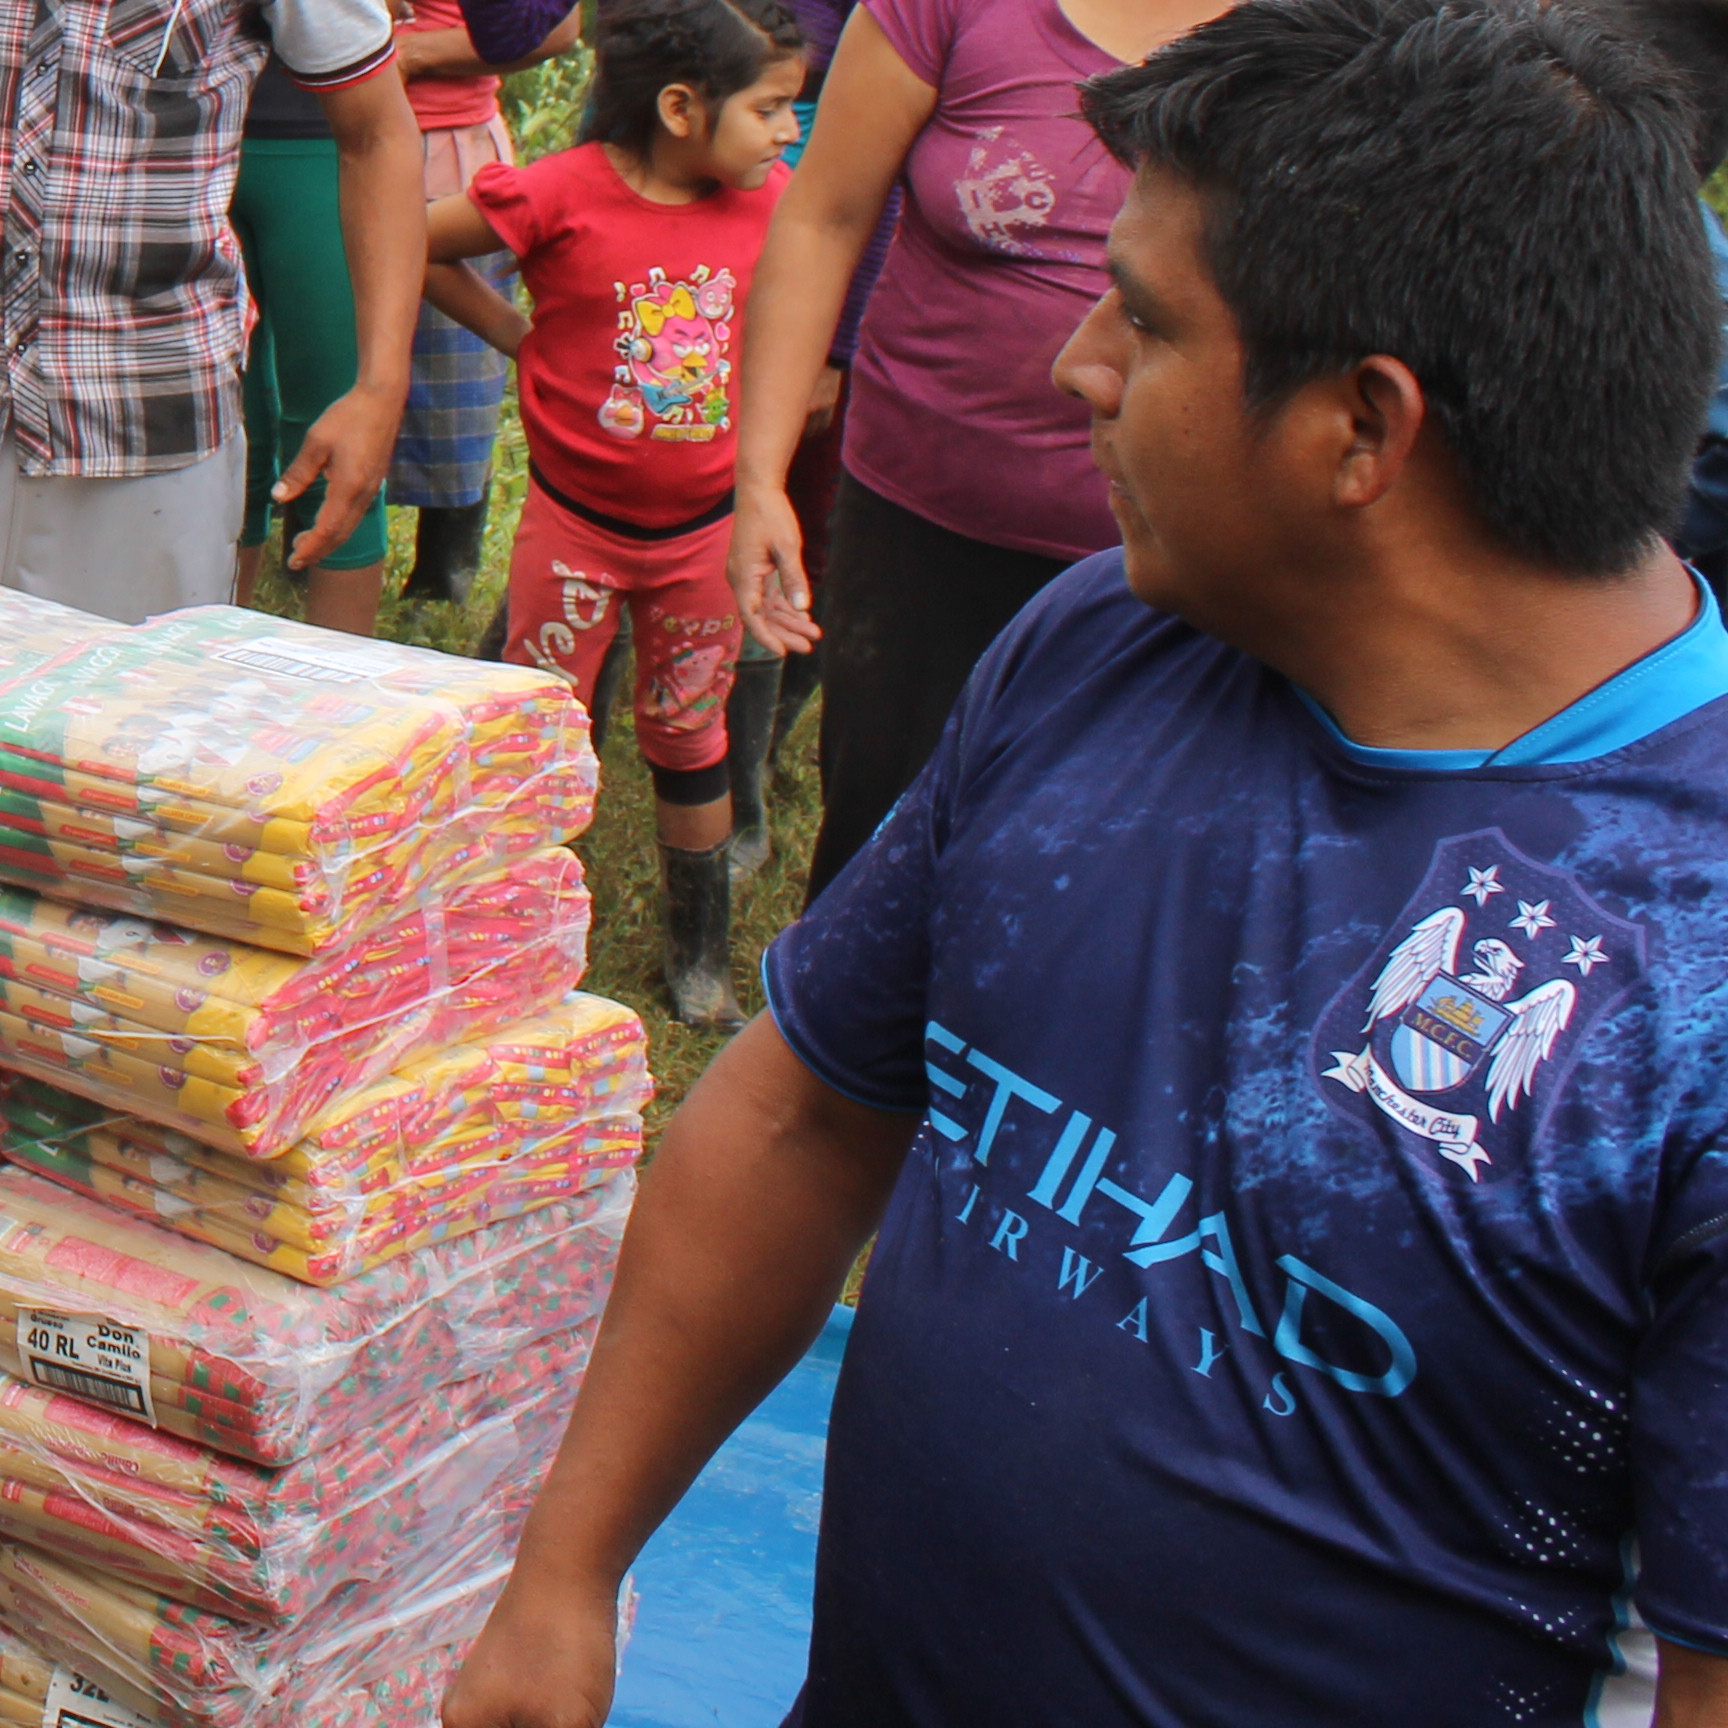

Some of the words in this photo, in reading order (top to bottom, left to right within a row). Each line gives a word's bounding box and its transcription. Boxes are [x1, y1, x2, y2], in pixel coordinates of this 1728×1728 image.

[1365, 1059, 1427, 1129] Manchester
[1428, 1117, 1462, 1138] City
[925, 1021, 1417, 1397] ETIHAD
[955, 1184, 1296, 1416] IRWAYS
[27, 1328, 49, 1351] 40
[56, 1334, 80, 1360] RL
[86, 1336, 141, 1359] Camilo
[97, 1324, 134, 1344] Don
